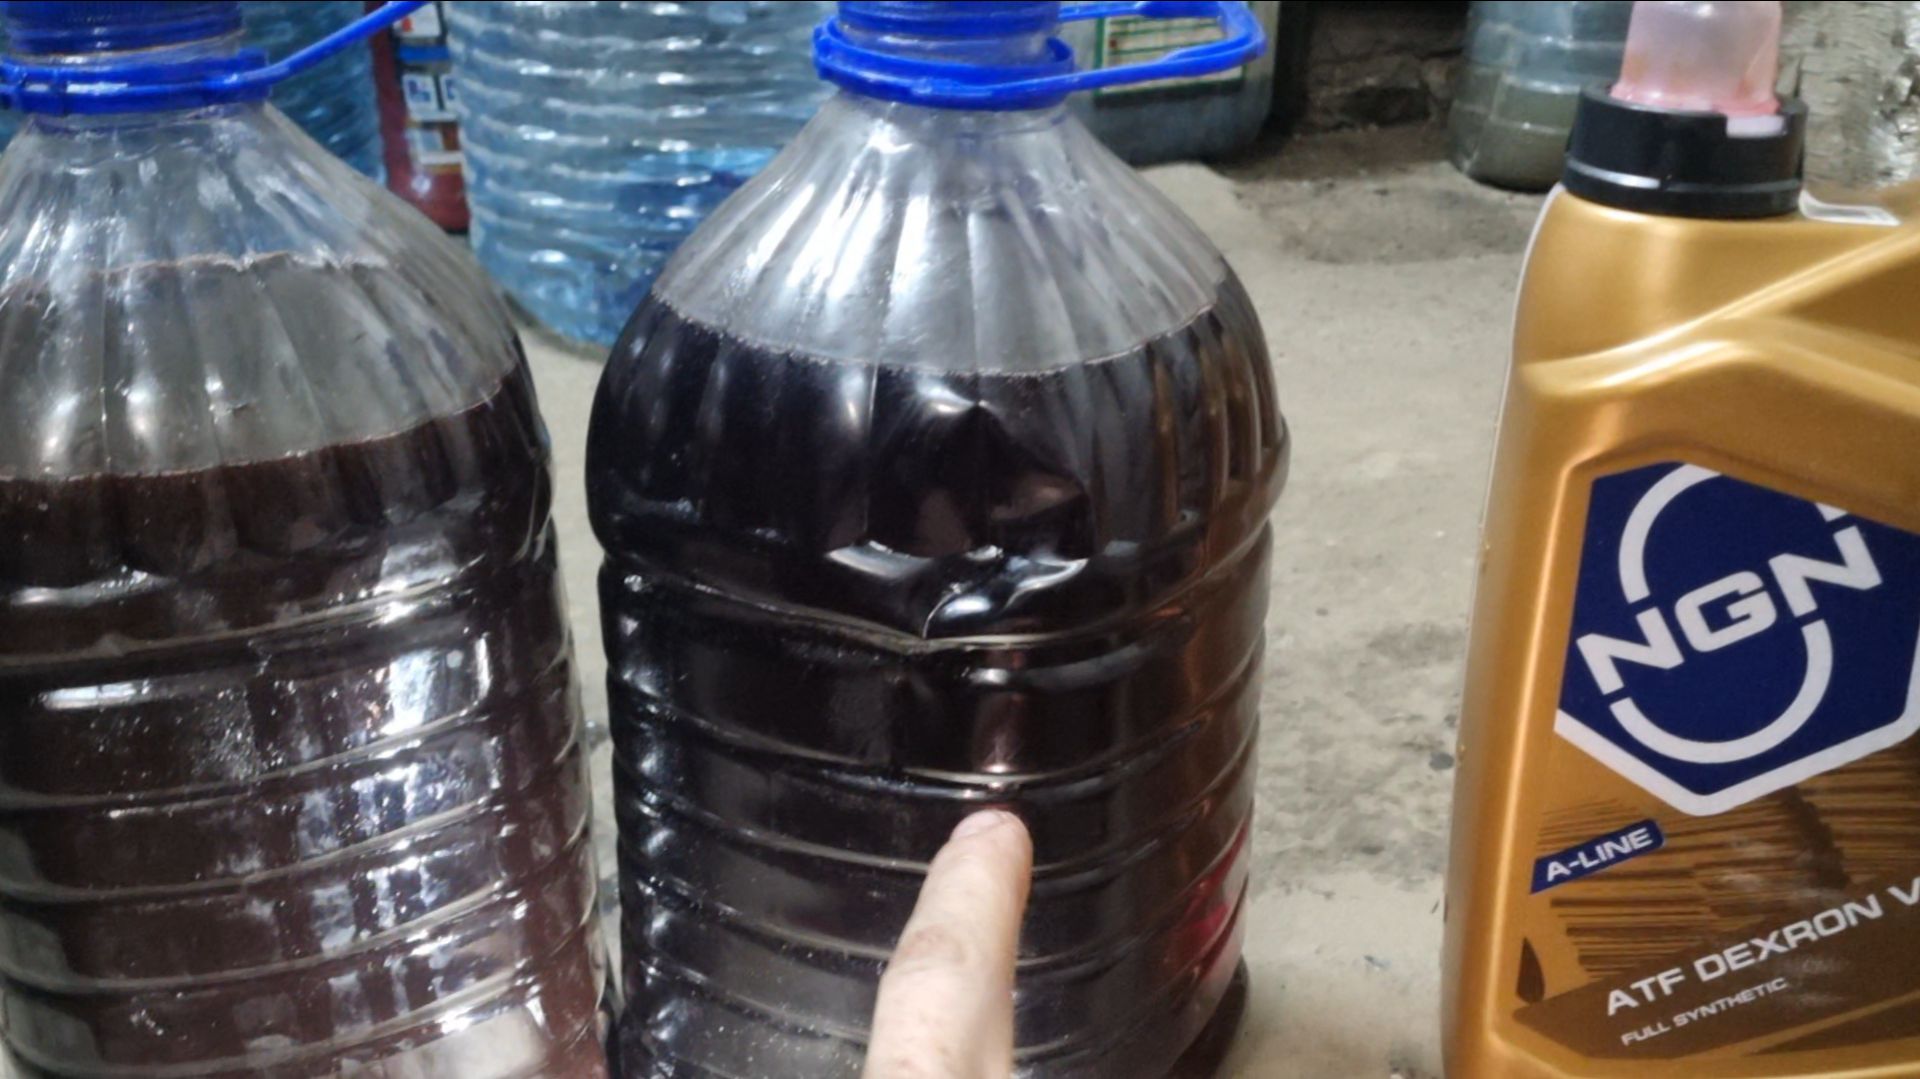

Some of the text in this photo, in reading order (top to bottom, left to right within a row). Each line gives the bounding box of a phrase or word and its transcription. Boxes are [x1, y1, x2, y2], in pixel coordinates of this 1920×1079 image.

[1576, 526, 1882, 694] NGN
[1546, 827, 1653, 882] A-LINE
[1606, 968, 1686, 1016] ATF
[1694, 895, 1883, 982] DEXRON
[1621, 977, 1787, 1046] FULL SYNTHETIC
